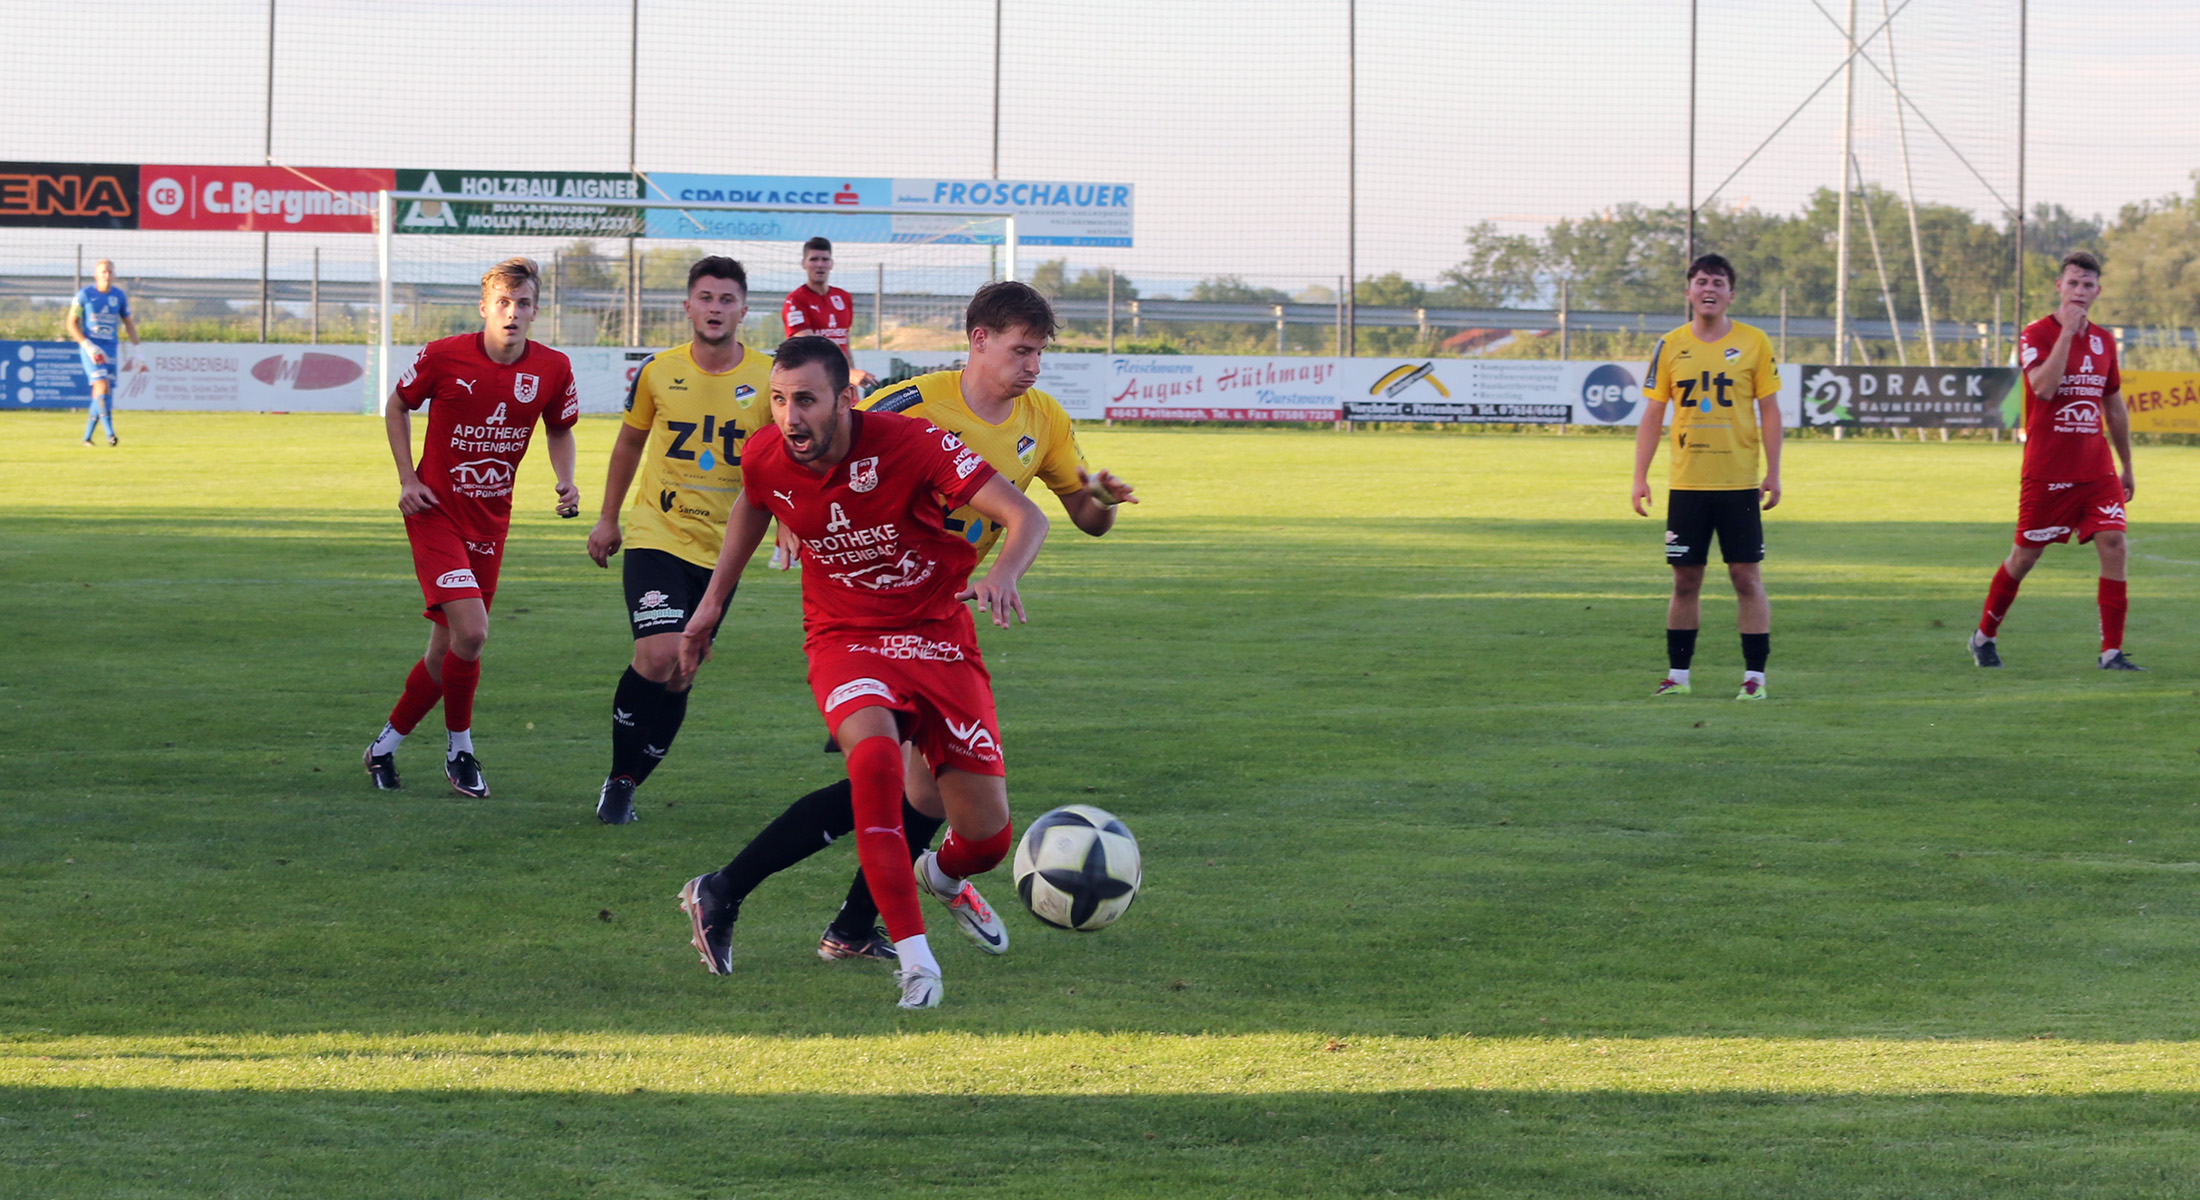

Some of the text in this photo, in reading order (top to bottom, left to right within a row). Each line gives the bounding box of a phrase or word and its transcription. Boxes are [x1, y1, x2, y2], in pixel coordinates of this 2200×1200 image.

[461, 177, 639, 199] HOLZBAU AIGNER
[933, 182, 1129, 207] FROSCHAUER
[467, 215, 524, 228] MOLLN
[678, 216, 780, 236] Pettenbach
[156, 356, 239, 372] FASSADENBAU
[1113, 363, 1334, 402] August Hüthmayr
[1858, 374, 1982, 396] DRACK
[1858, 402, 1983, 413] RAUMEXPERTEN
[453, 424, 531, 440] APOTHEKE
[451, 437, 526, 453] PETTENBACH
[678, 505, 711, 517] Sanova
